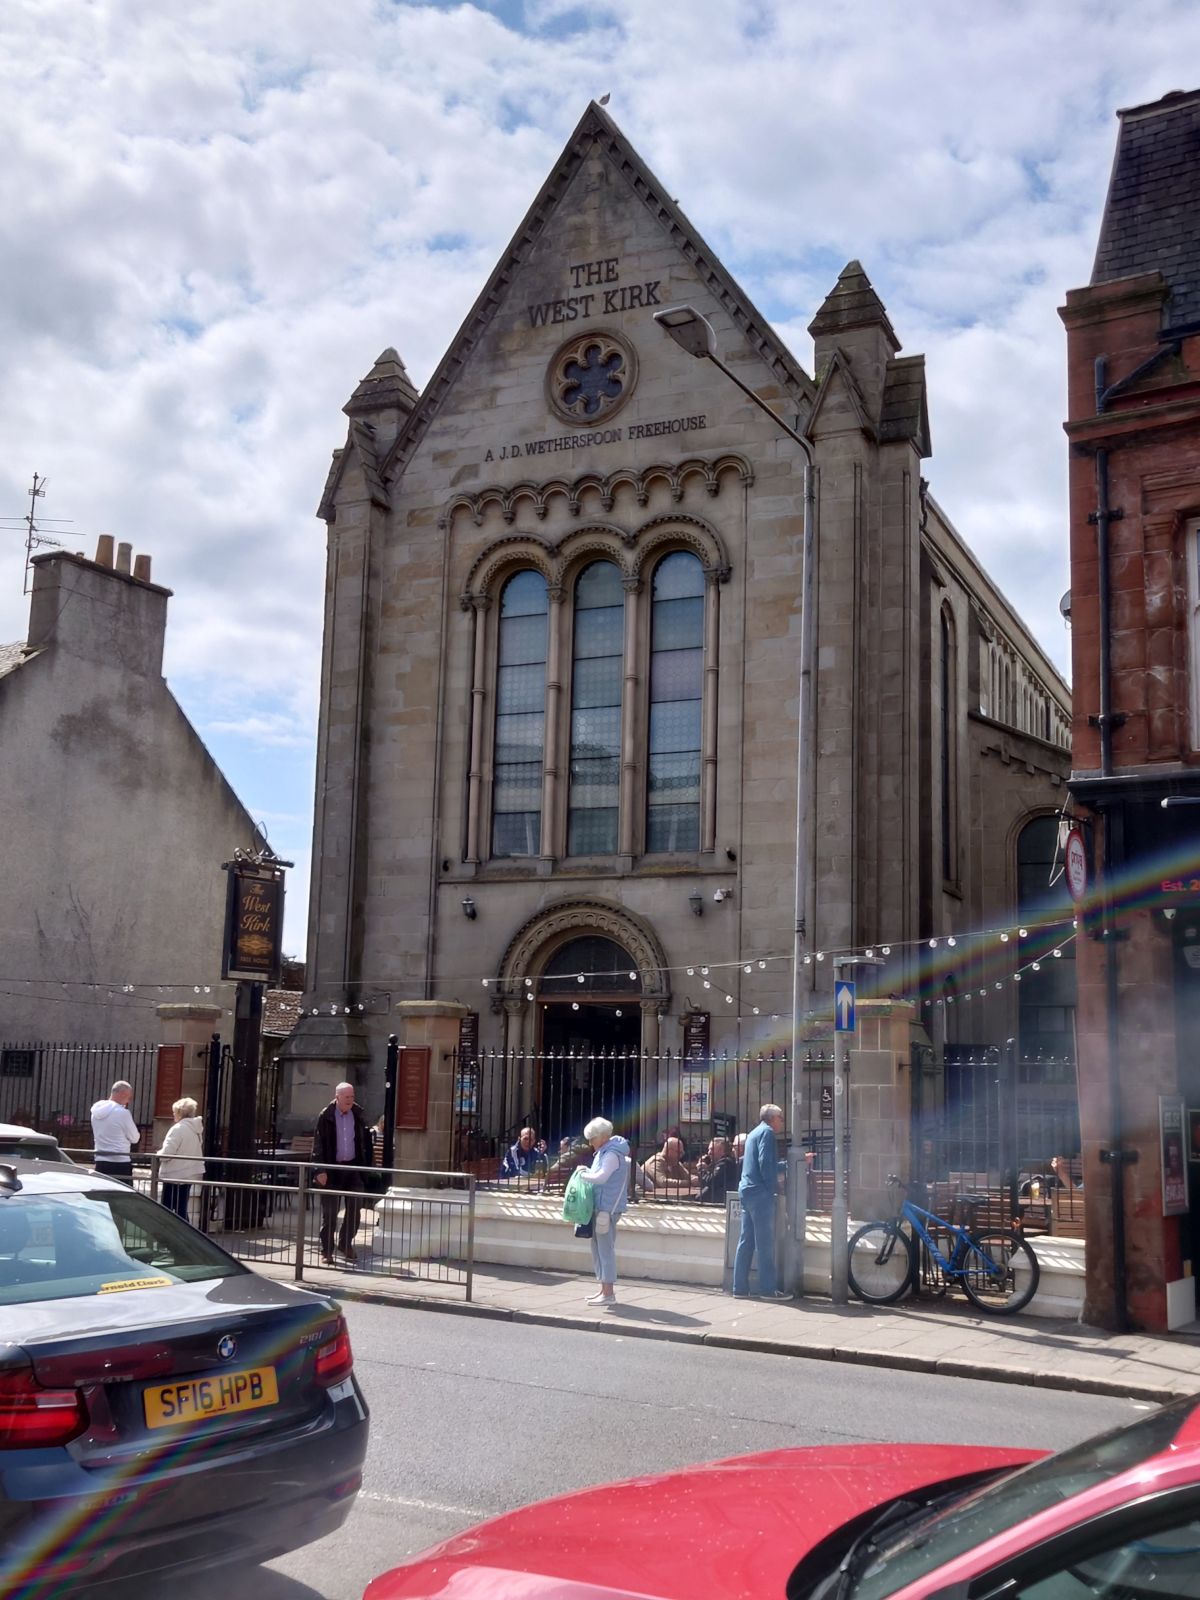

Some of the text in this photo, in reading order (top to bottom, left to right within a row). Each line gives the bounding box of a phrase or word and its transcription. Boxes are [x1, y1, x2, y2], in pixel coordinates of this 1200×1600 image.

[570, 258, 619, 288] THE
[528, 281, 661, 328] WEST KIRK
[484, 449, 495, 462] A
[525, 428, 622, 456] WETHERSPOON
[628, 415, 707, 440] FREEHOUSE
[240, 914, 271, 932] Kirk
[242, 896, 271, 913] West
[160, 1373, 263, 1417] SF16 HPB
